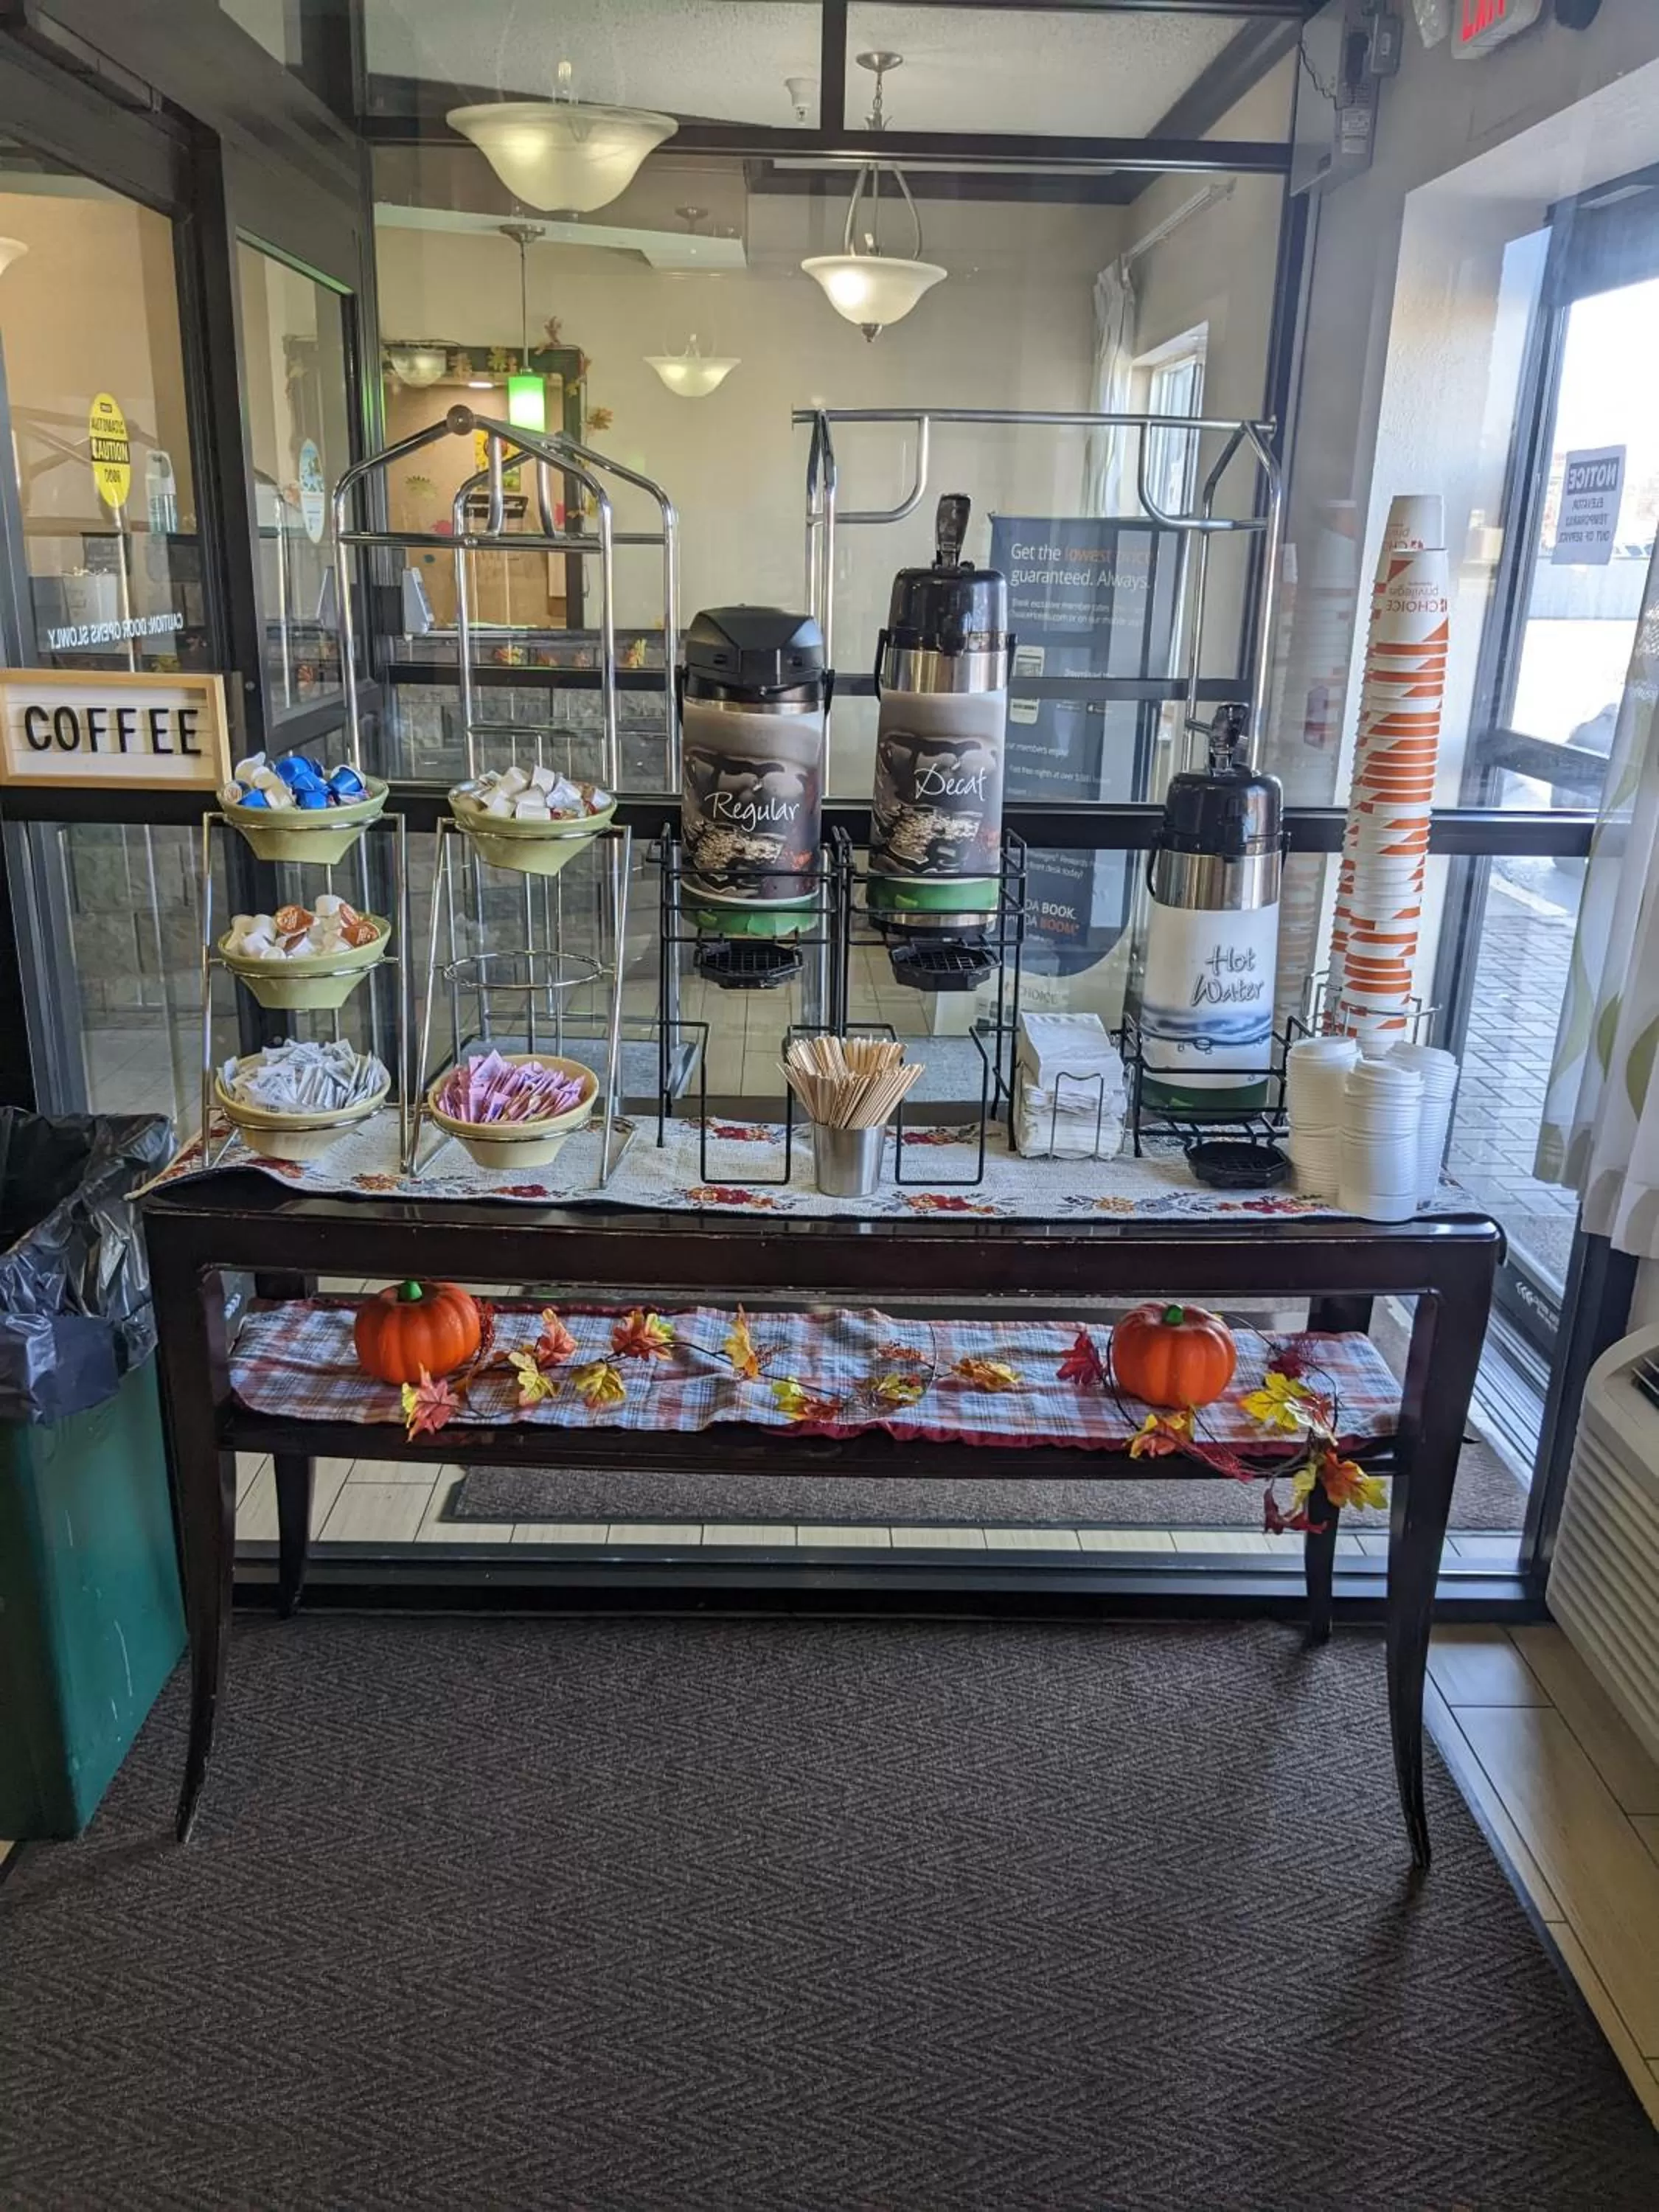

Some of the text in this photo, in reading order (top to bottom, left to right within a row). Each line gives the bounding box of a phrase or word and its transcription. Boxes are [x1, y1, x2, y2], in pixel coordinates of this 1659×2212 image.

[92, 437, 128, 462] CAUTION
[1011, 543, 1034, 560] Get
[1038, 544, 1062, 562] the
[1010, 568, 1150, 591] guaranteed. Always.
[24, 706, 202, 755] COFFEE
[704, 793, 800, 832] Regular
[1206, 945, 1256, 976] Hot
[1191, 974, 1265, 1007] Water
